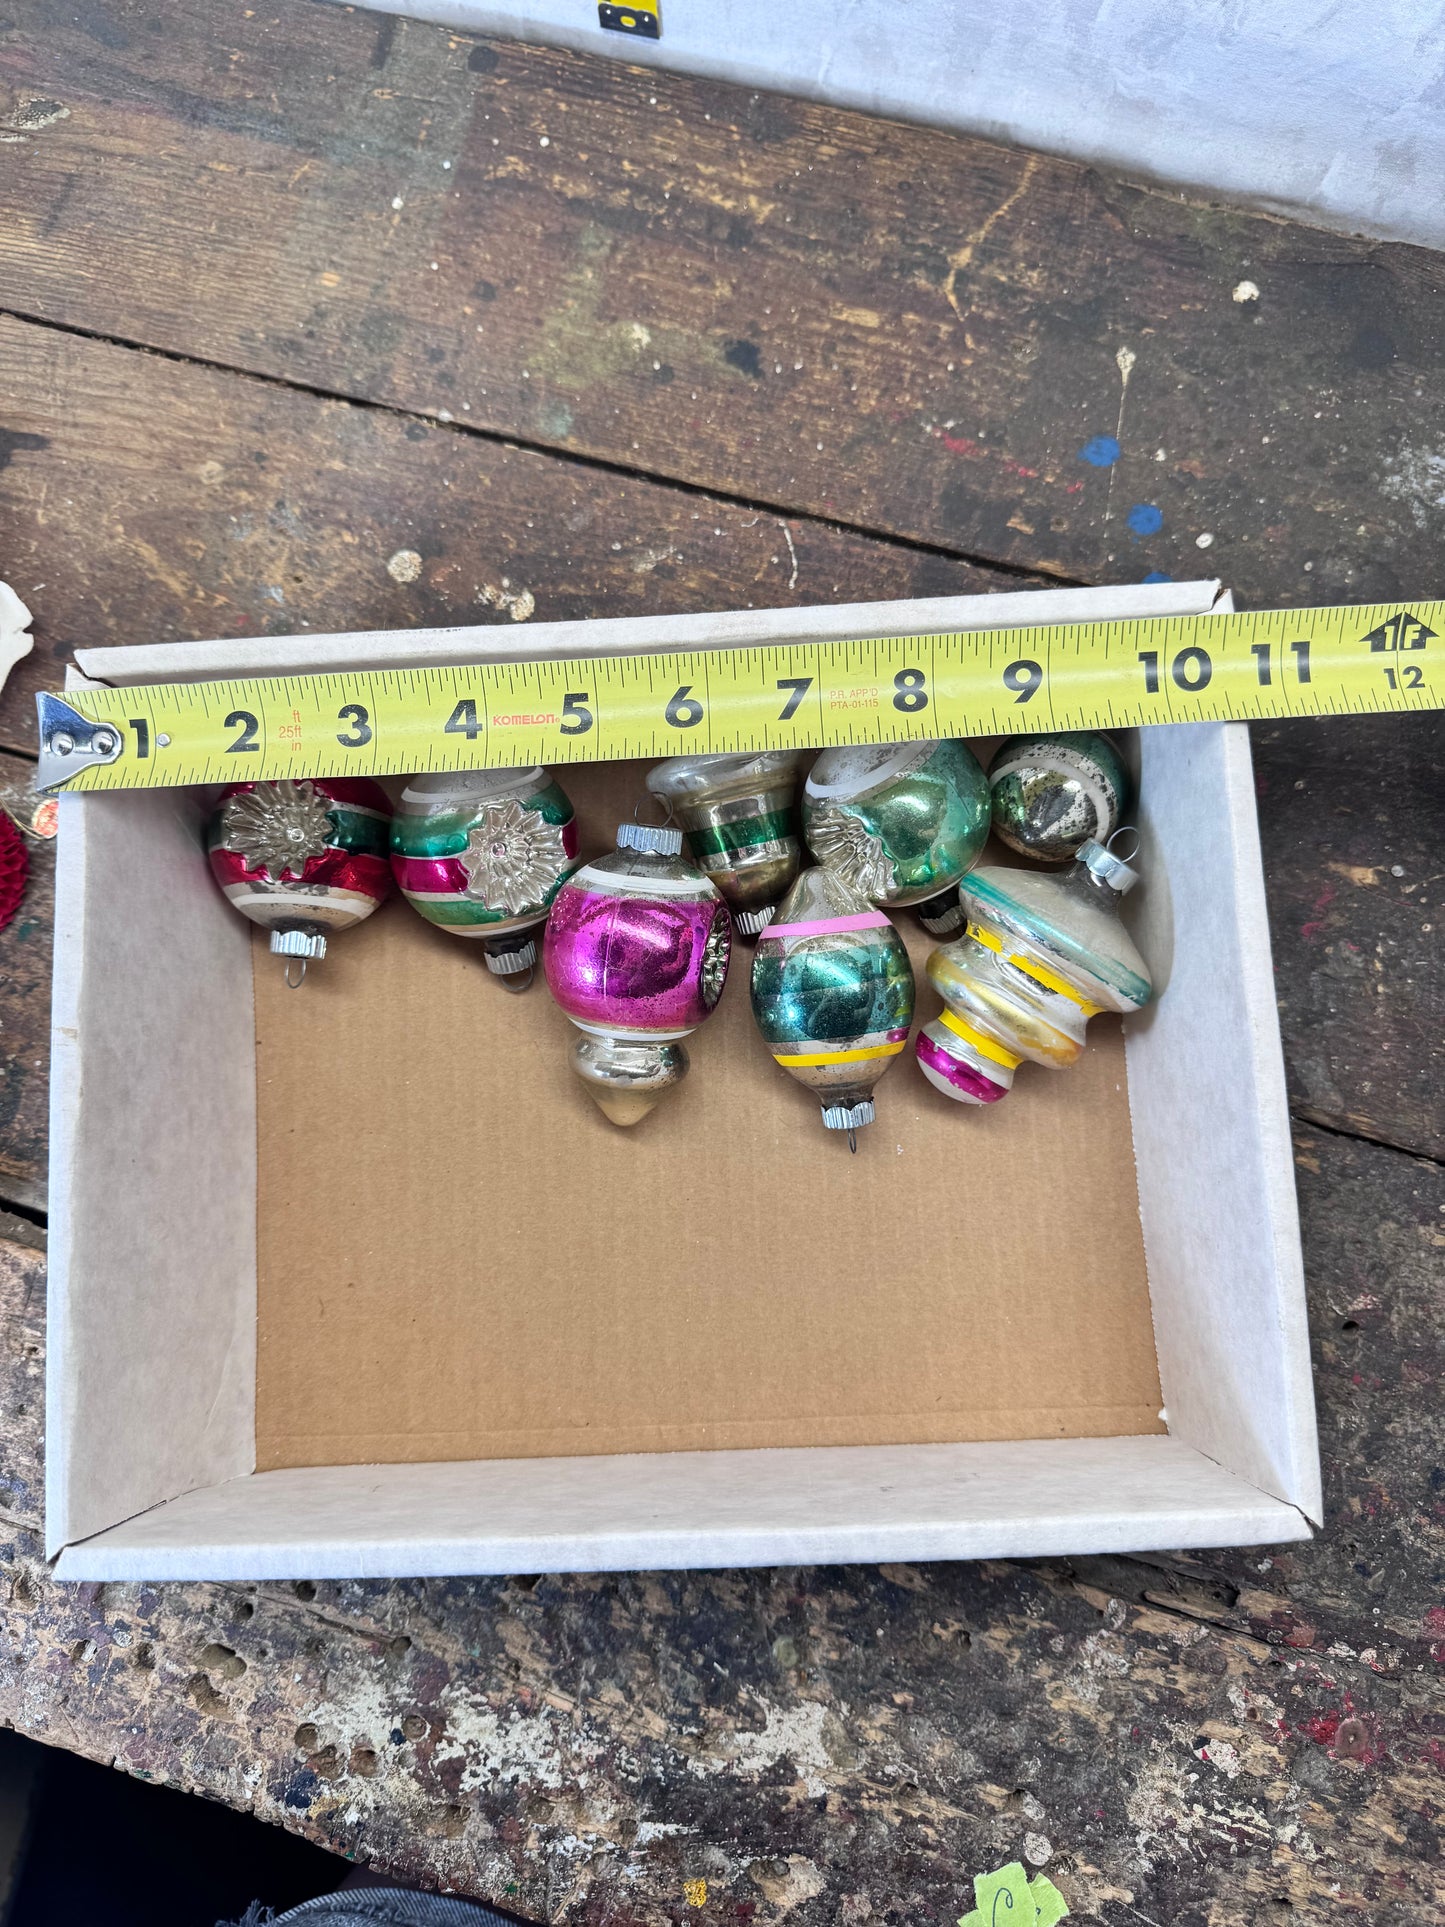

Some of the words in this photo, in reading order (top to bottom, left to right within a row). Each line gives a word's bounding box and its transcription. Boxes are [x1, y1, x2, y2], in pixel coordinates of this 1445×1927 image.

[1002, 659, 1043, 704] 9
[1138, 646, 1212, 694] 10
[1250, 640, 1312, 686] 11
[1383, 665, 1426, 690] 12
[664, 685, 704, 728] 6
[776, 677, 814, 720] 7
[830, 698, 879, 710] PTA-01-115
[892, 668, 929, 712] 8
[223, 710, 260, 753] 2
[279, 725, 302, 738] 25ft
[292, 709, 301, 723] ft
[336, 703, 373, 748] 3
[444, 699, 483, 740] 4
[559, 692, 594, 735] 5
[129, 718, 149, 758] 1
[291, 741, 302, 751] in
